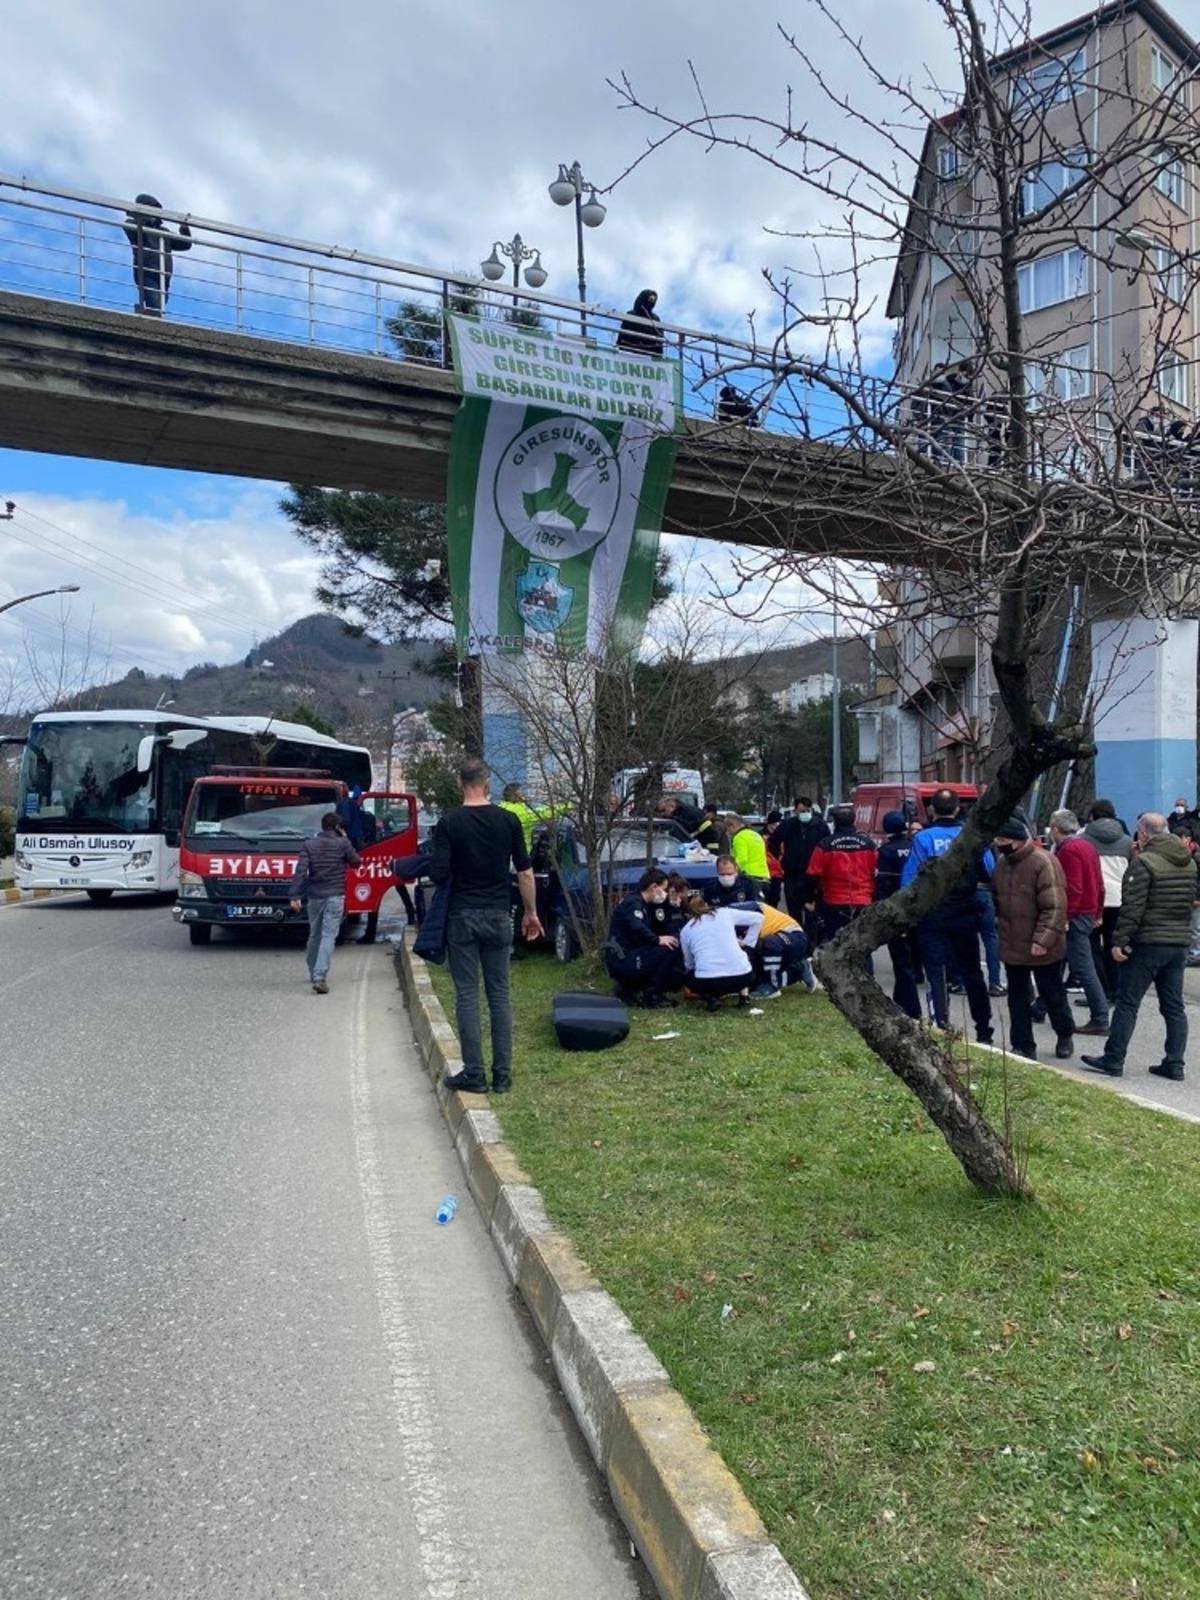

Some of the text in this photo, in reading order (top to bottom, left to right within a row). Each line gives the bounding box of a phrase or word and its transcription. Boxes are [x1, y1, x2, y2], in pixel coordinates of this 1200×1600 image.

[468, 327, 668, 383] SÜPER LİG YOLUNDA
[493, 354, 653, 400] GİRESUNSPOR'A
[476, 372, 664, 423] BAŞARILAR DİLERİZ
[512, 427, 610, 485] GİRESUNSPOR
[535, 531, 566, 549] 1967
[22, 837, 136, 851] Ali Osman Ulusoy
